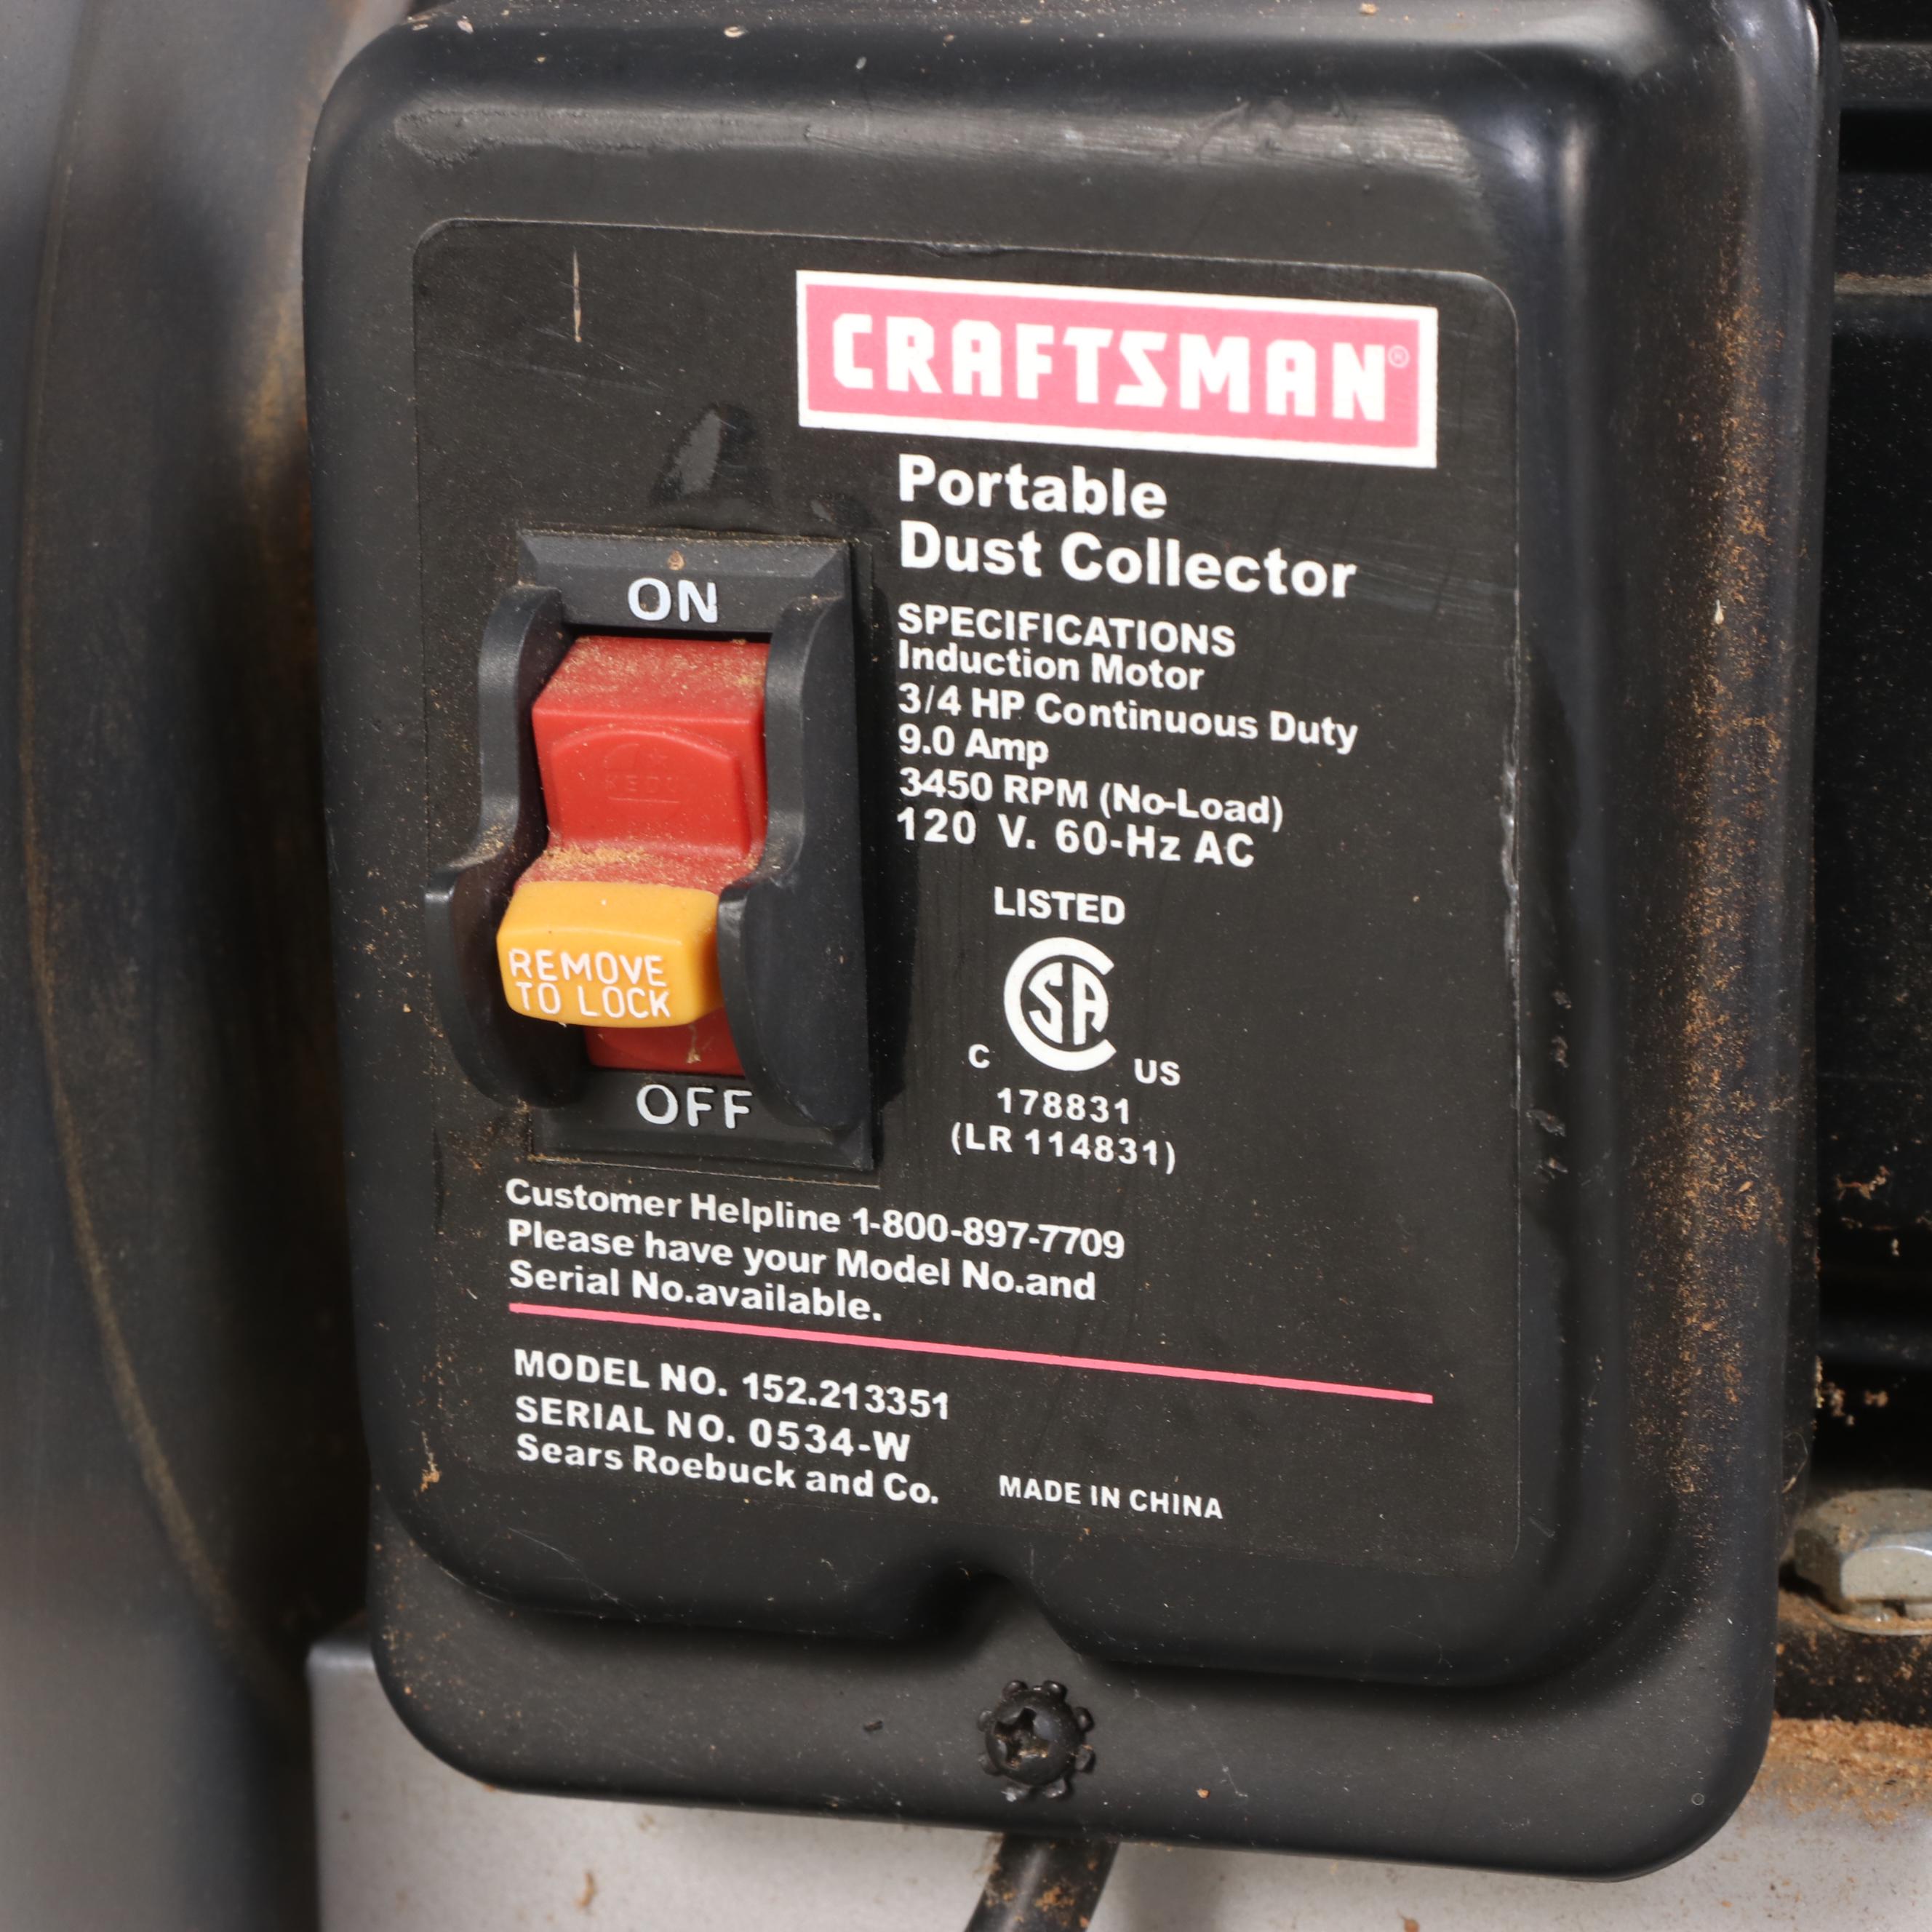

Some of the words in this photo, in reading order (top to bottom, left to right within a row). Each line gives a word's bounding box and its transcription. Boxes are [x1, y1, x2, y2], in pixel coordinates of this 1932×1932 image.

[832, 313, 1386, 421] CRAFTSMAN
[899, 454, 1167, 519] Portable
[901, 520, 1042, 578] Dust
[1061, 532, 1357, 598] Collector
[628, 578, 717, 623] ON
[898, 603, 1235, 657] SPECIFICATIONS
[899, 639, 1079, 682] Induction
[1091, 652, 1205, 690] Motor
[898, 682, 962, 716] 3/4
[972, 687, 1025, 719] HP
[1035, 692, 1258, 739] Continuous
[1270, 711, 1358, 754] Duty
[898, 723, 955, 756] 9.0
[965, 728, 1049, 770] Amp
[900, 767, 993, 802] 3450
[1004, 775, 1088, 809] RPM
[1100, 783, 1282, 832] (No-Load)
[898, 807, 975, 845] 120
[998, 814, 1035, 850] V.
[1055, 819, 1181, 861] 60-Hz
[1194, 831, 1254, 867] AC
[994, 887, 1125, 925] LISTED
[508, 948, 666, 987] REMOVE
[515, 981, 562, 1015] TO
[577, 984, 671, 1019] LOCK
[968, 1044, 990, 1069] C
[1135, 1058, 1180, 1086] US
[636, 1085, 751, 1128] OFF
[997, 1087, 1128, 1124] 178831
[951, 1122, 1013, 1155] (LR
[1025, 1129, 1175, 1174] 114831)
[506, 1178, 682, 1218] Customer
[691, 1193, 840, 1232] Helpline
[853, 1208, 1125, 1259] 1-800-897-7709
[508, 1218, 634, 1256] Please
[645, 1231, 733, 1266] have
[743, 1247, 826, 1276] your
[837, 1248, 950, 1285] Model
[509, 1260, 619, 1296] Serial
[514, 1349, 650, 1388] MODEL
[660, 1363, 727, 1396] NO.
[743, 1373, 948, 1420] 152.213351
[516, 1395, 655, 1435] SERIAL
[668, 1410, 735, 1443] NO.
[749, 1418, 910, 1461] 0534-W
[516, 1433, 623, 1470] Sears
[634, 1445, 796, 1488] Roebuck
[806, 1469, 873, 1497] and
[883, 1472, 938, 1504] Co.
[999, 1475, 1081, 1504] MADE
[1090, 1485, 1120, 1509] IN
[1130, 1489, 1223, 1519] CHINA
